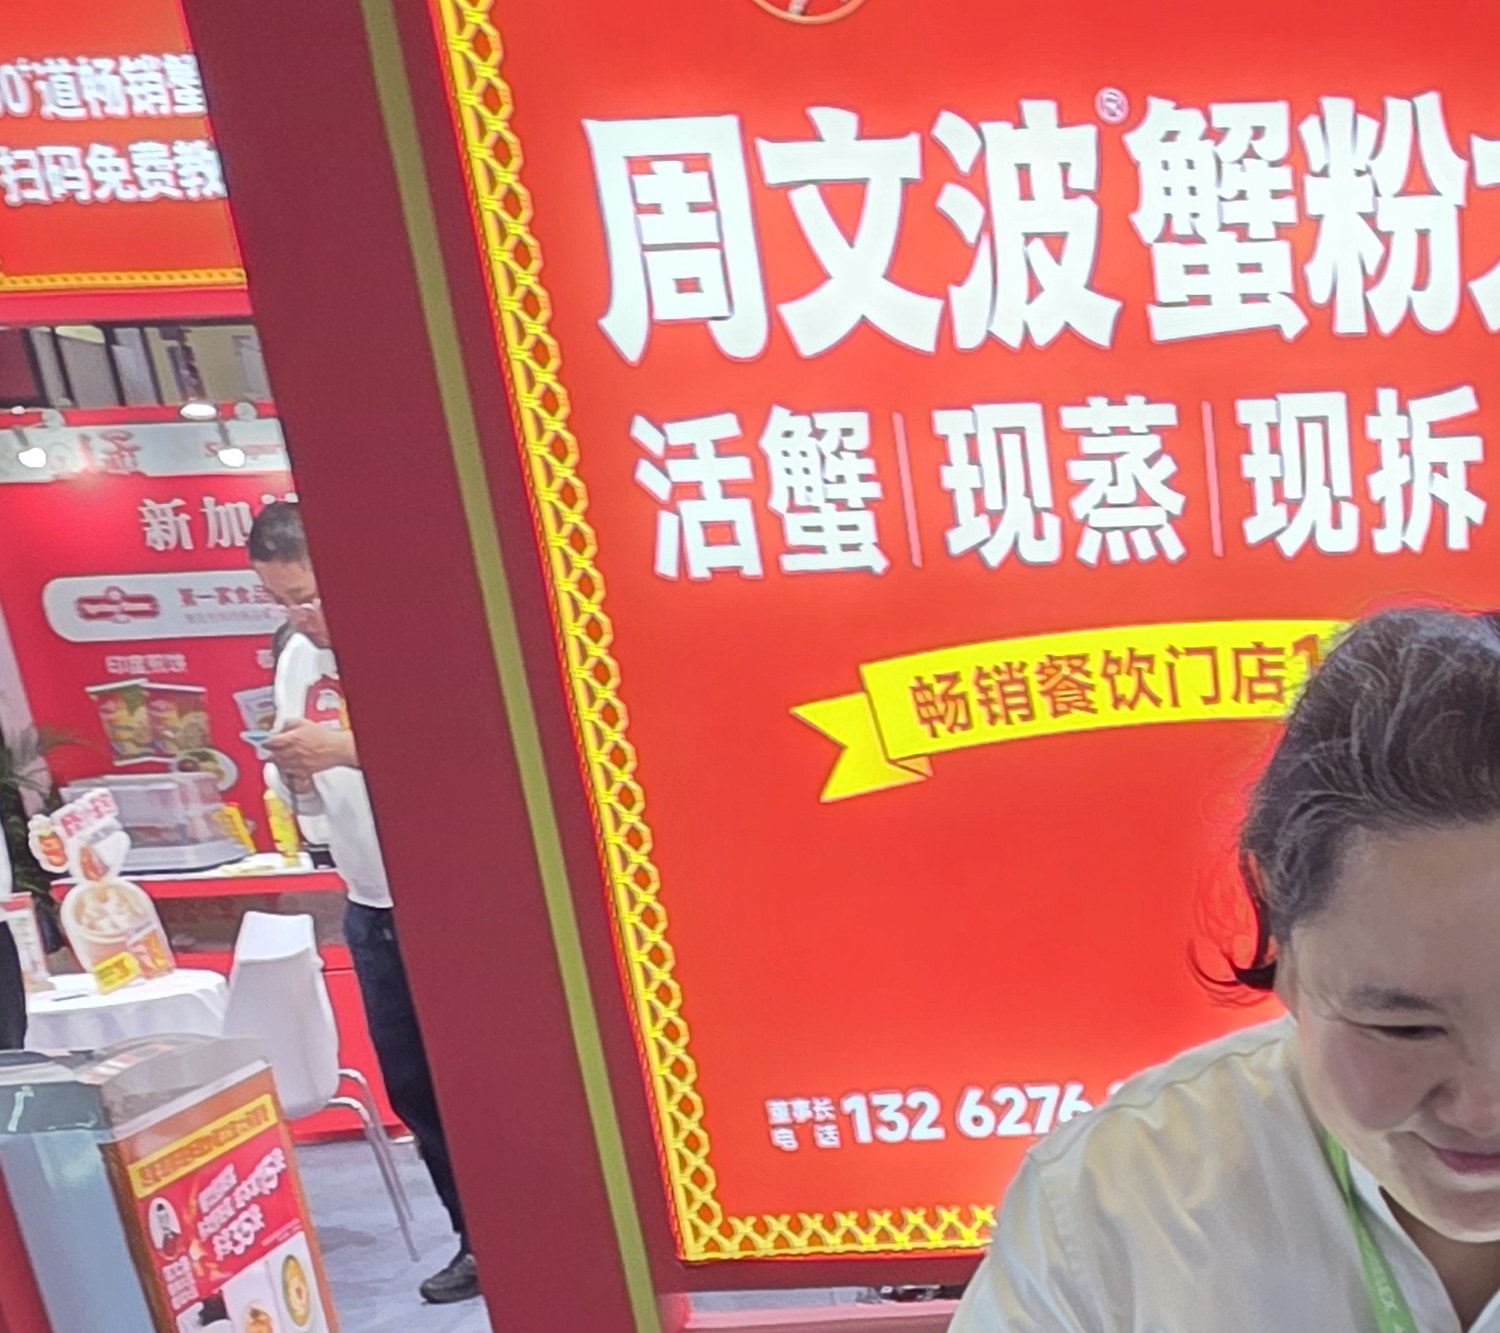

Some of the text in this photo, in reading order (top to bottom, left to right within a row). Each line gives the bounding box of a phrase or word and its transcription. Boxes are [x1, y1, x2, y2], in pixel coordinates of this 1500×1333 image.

[630, 404, 890, 579] 活蟹
[932, 394, 1187, 568] 现蒸
[1235, 384, 1487, 558] 现拆
[842, 1088, 946, 1144] 132
